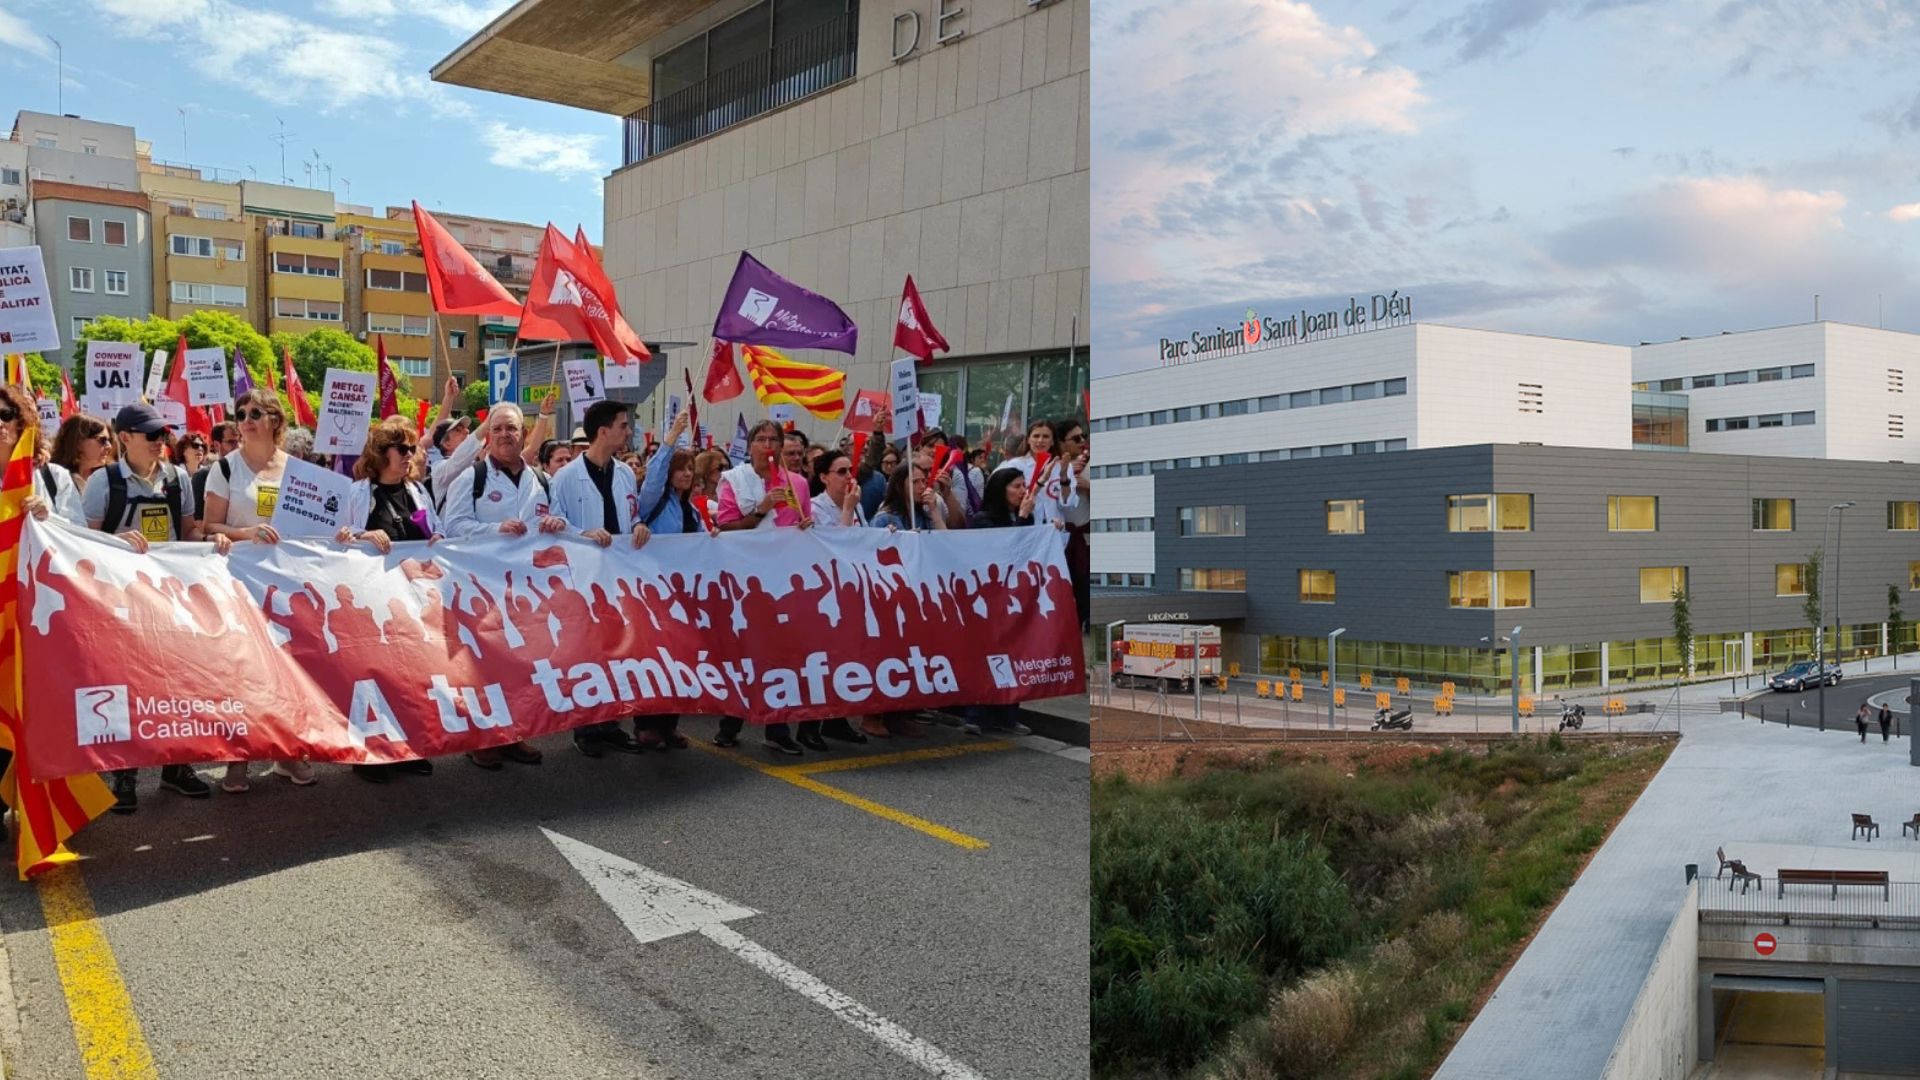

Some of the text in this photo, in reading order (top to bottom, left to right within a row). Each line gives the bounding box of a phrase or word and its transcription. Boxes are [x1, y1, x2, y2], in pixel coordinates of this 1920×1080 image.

[891, 0, 964, 62] DE
[1160, 290, 1412, 360] Parc Sanitari Sant Joan de Déu
[94, 352, 132, 360] CONVENI
[94, 370, 130, 389] JA!
[331, 381, 365, 393] METGE
[494, 363, 511, 401] P
[330, 391, 368, 404] CANSAT,
[290, 475, 318, 492] Tanta
[284, 494, 304, 506] ens
[287, 486, 323, 503] espera
[282, 502, 336, 527] desespera
[1013, 653, 1072, 672] Metges de
[1018, 669, 1075, 686] Catalunya
[348, 679, 407, 746] A
[427, 675, 512, 734] tu
[531, 645, 727, 713] també
[136, 696, 244, 719] Metges de
[137, 718, 248, 742] Catalunya
